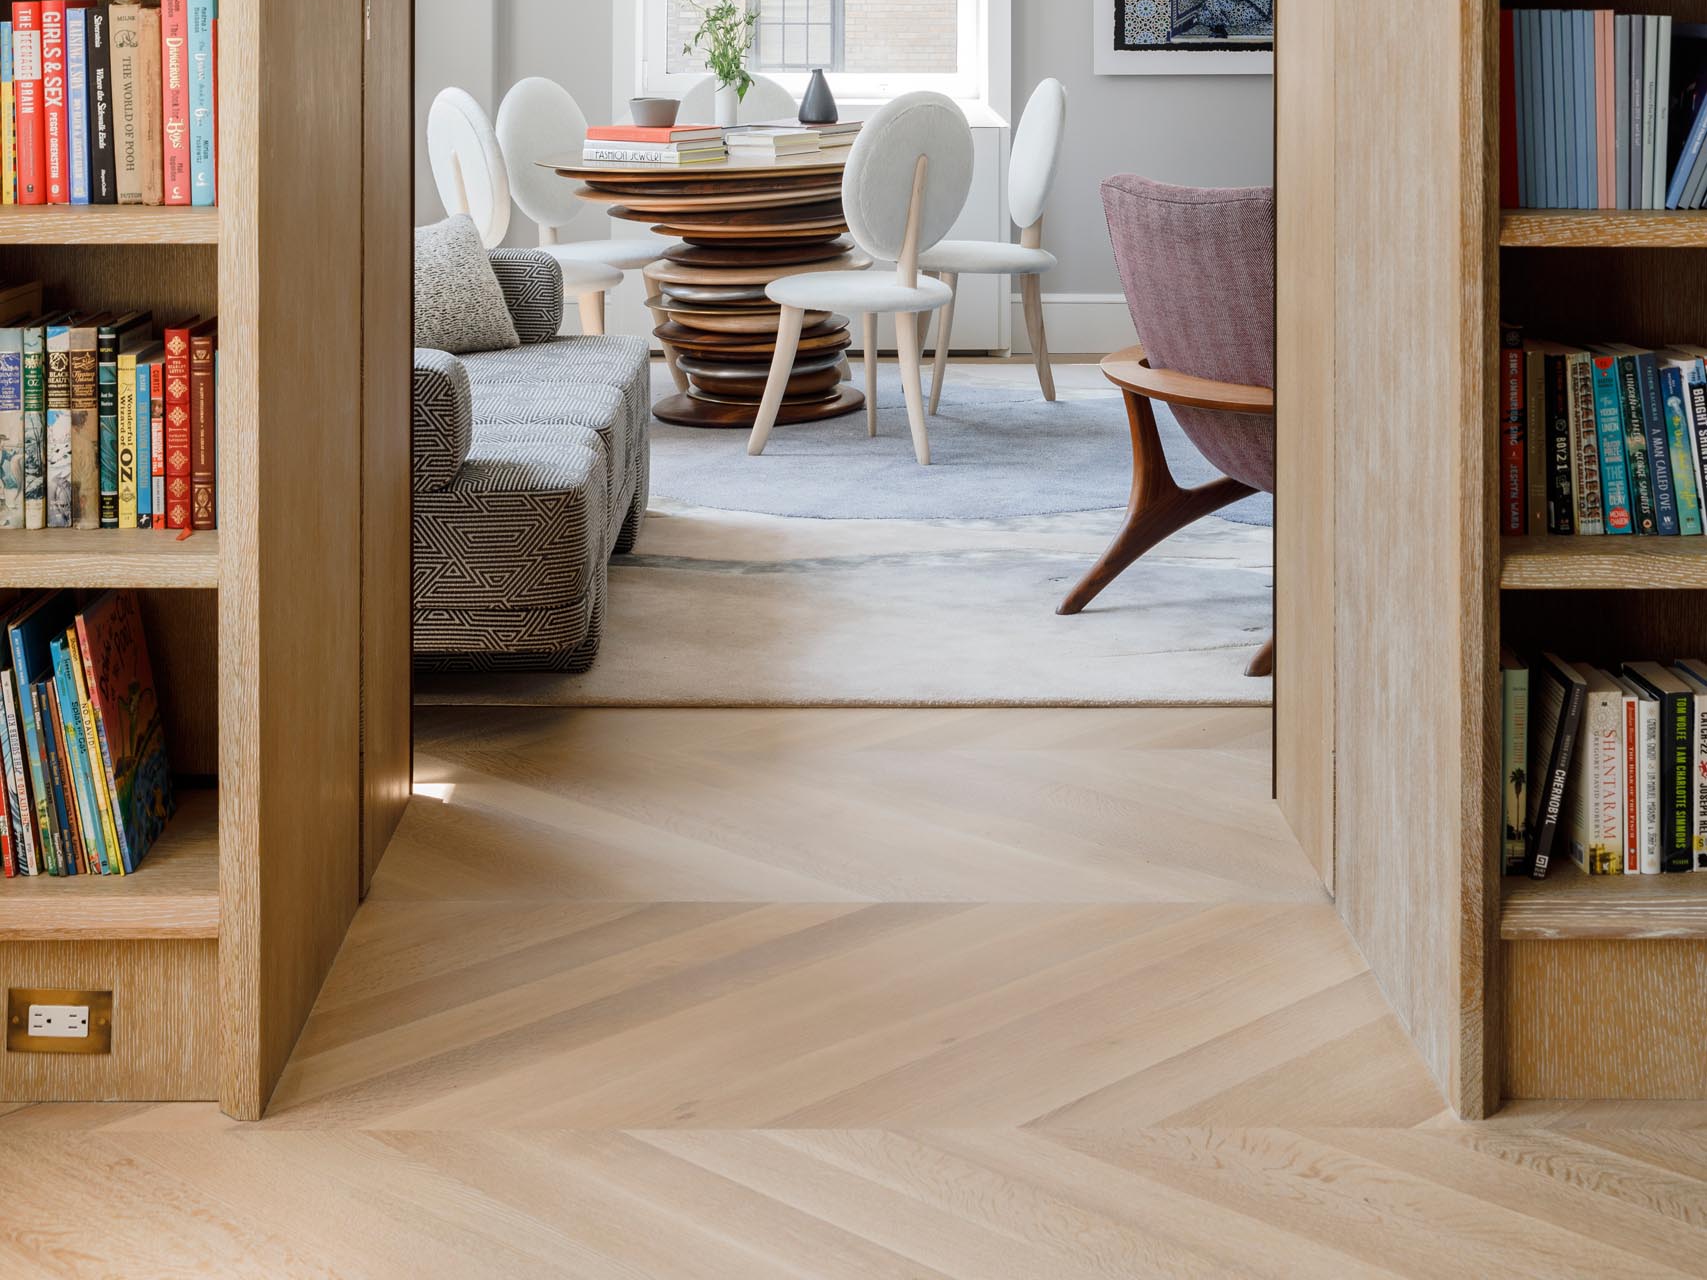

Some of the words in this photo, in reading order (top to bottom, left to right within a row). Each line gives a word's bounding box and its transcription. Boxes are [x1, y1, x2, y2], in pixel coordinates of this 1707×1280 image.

[19, 9, 32, 28] THE
[93, 15, 103, 48] Silverstein
[43, 12, 61, 58] GIRLS
[19, 32, 33, 78] TEENAGE
[44, 62, 62, 73] &
[122, 56, 133, 79] THE
[44, 77, 63, 107] SEX
[95, 68, 104, 89] Where
[21, 82, 34, 114] BRAIN
[123, 83, 134, 122] WORLD
[50, 112, 58, 136] PEGGY
[97, 102, 106, 131] Sidewalk
[124, 124, 134, 138] OF
[98, 132, 106, 149] Ends
[50, 138, 59, 178] ORENSTEIN
[125, 141, 135, 171] POOH
[1578, 362, 1595, 440] MICHAEL
[1693, 388, 1706, 426] BRIGHT
[120, 436, 126, 446] of
[1601, 424, 1619, 432] UNION
[1653, 437, 1664, 457] MAN
[120, 448, 133, 482] OZ
[1655, 460, 1668, 491] CALLED
[1583, 444, 1601, 519] CHABON
[1659, 493, 1671, 511] OVE
[1677, 697, 1687, 714] TOM
[1677, 716, 1687, 740] WOLFE
[1676, 751, 1687, 763] AM
[1545, 769, 1566, 825] CHERNOBYL
[1602, 730, 1617, 839] SHANTARAM
[1676, 765, 1687, 808] CHARLOTTE
[1699, 783, 1707, 817] JOSEPH
[1676, 811, 1687, 848] SIMMONS
